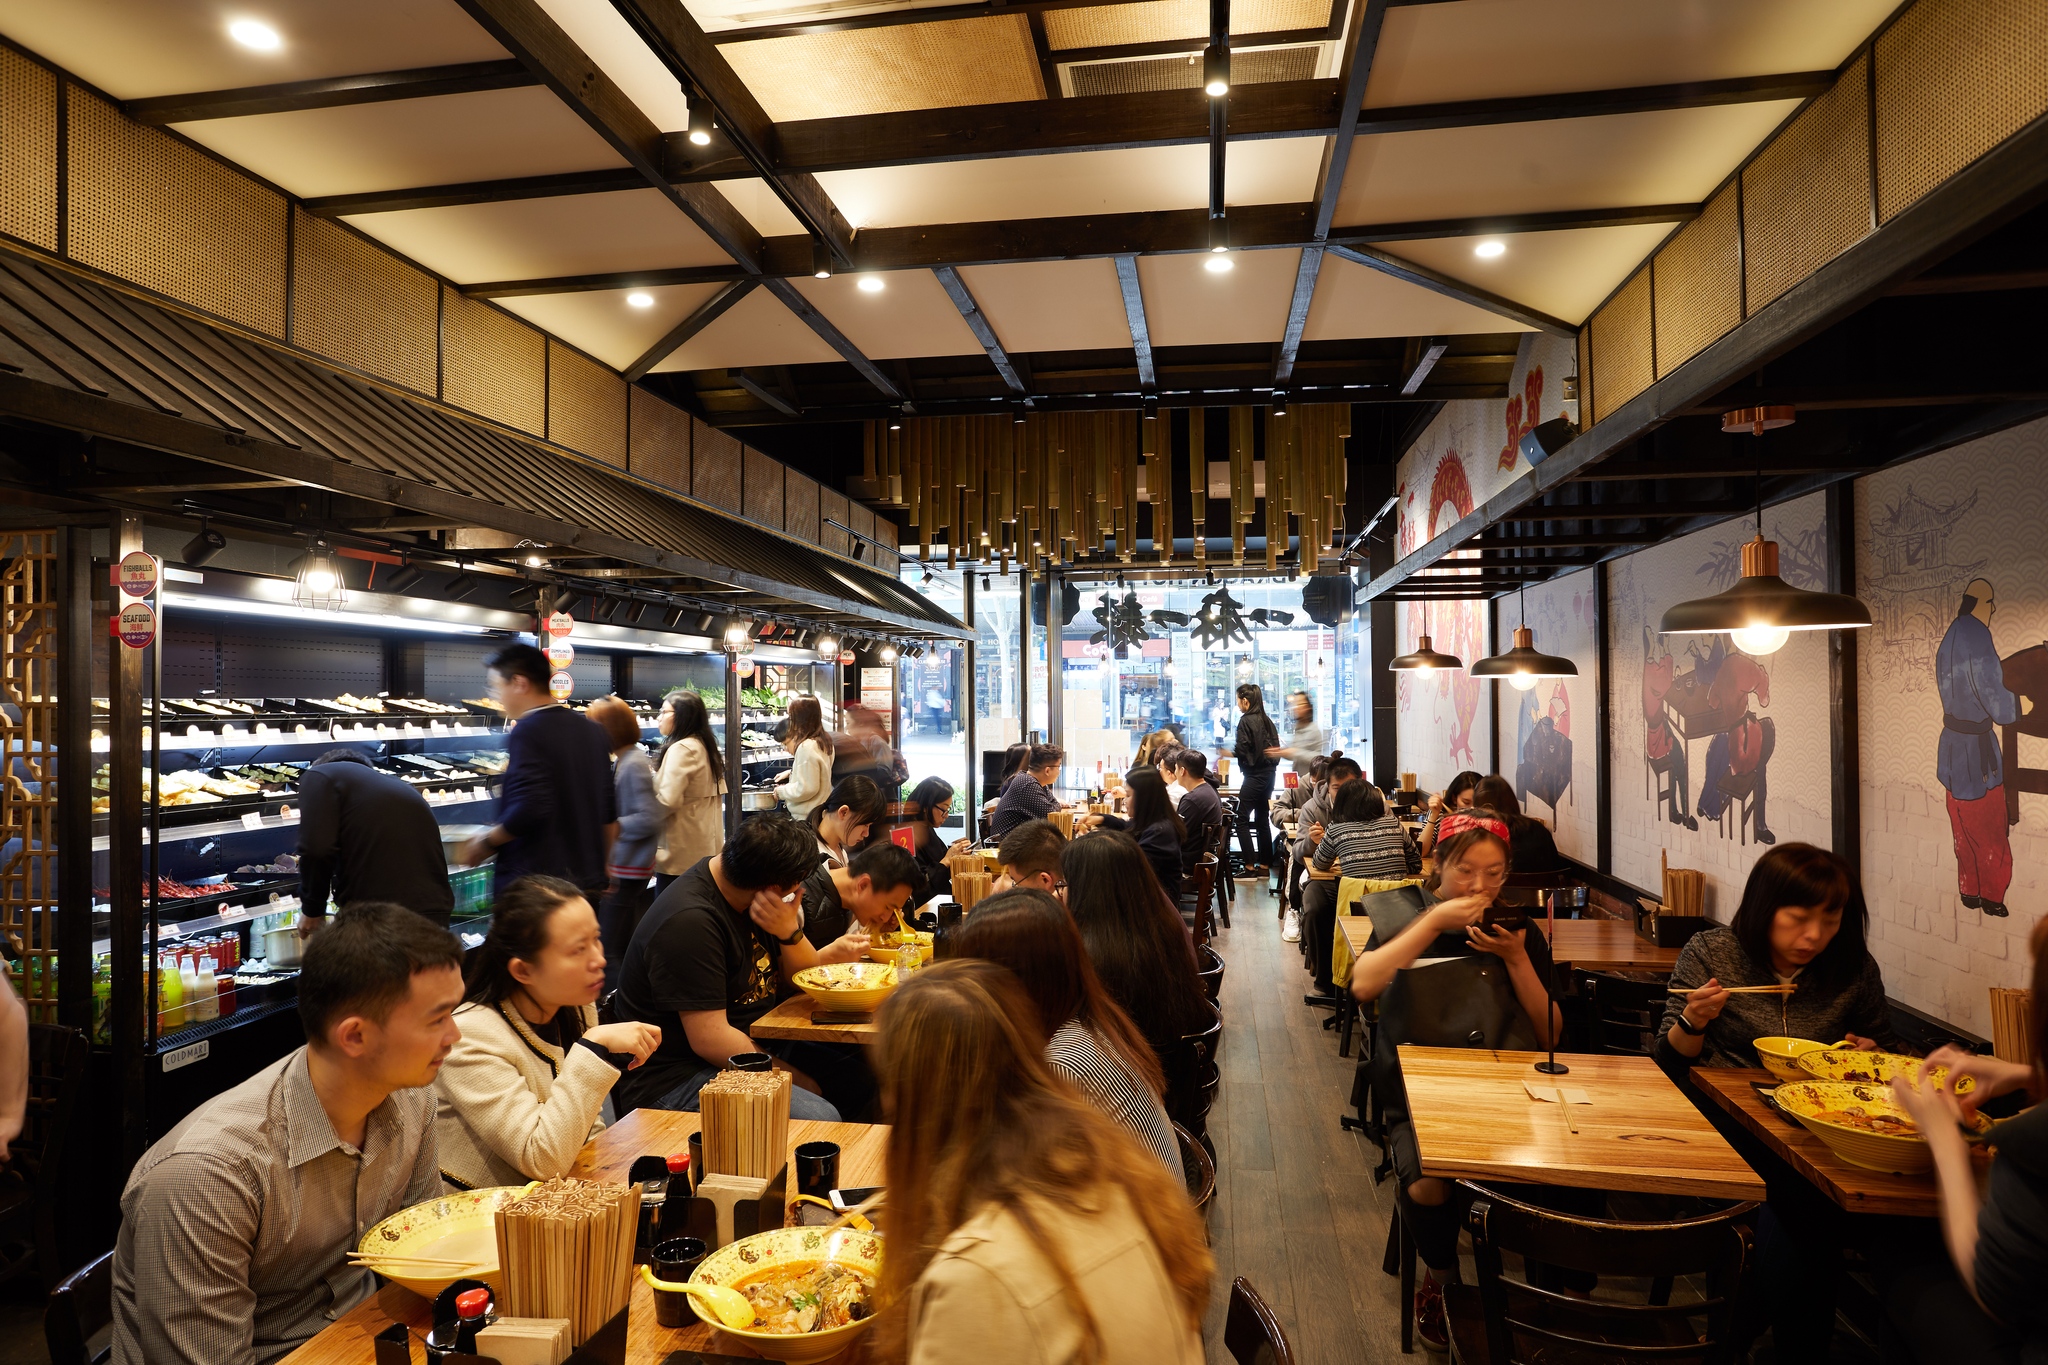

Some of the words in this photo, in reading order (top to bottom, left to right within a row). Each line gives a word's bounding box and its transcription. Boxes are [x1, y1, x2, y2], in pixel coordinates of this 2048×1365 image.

[131, 572, 146, 580] 魚丸
[123, 614, 150, 623] SEAFOOD
[1285, 776, 1297, 785] 16
[165, 1043, 207, 1065] COLDMART
